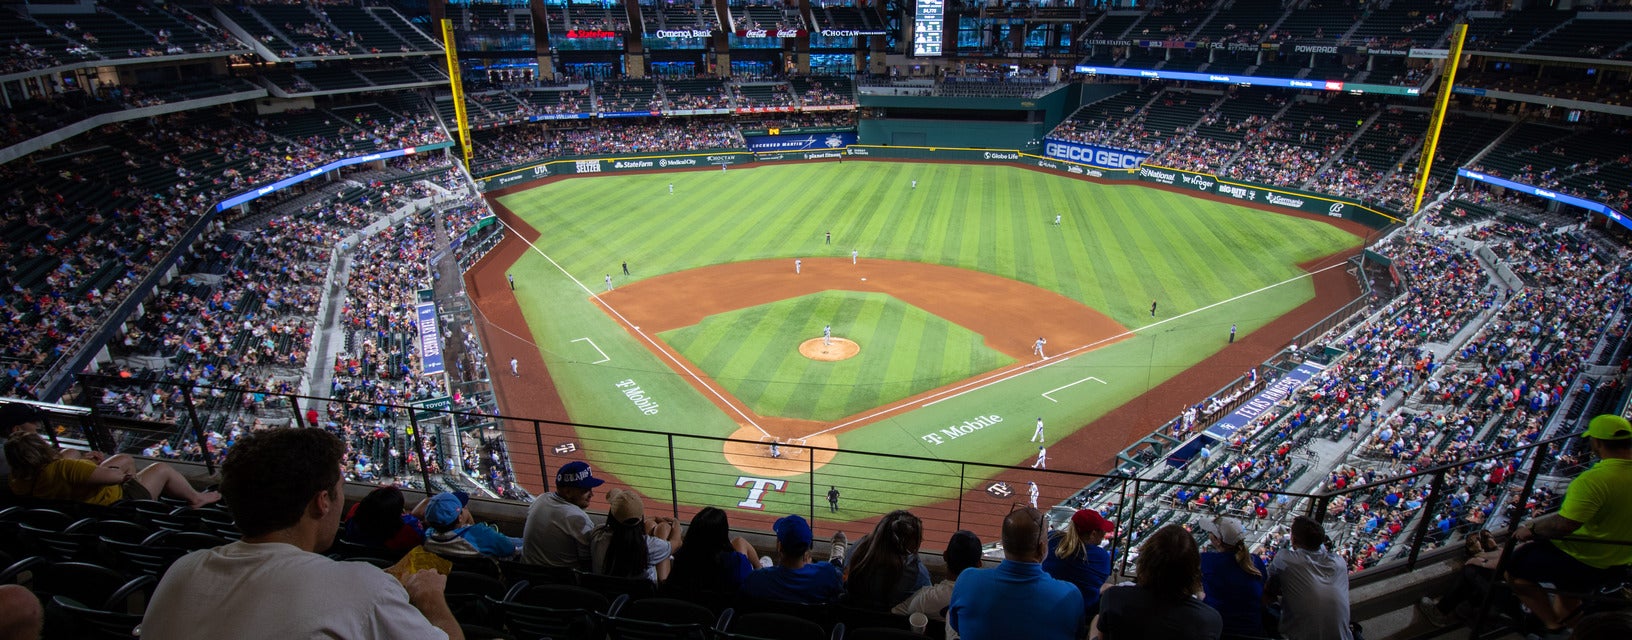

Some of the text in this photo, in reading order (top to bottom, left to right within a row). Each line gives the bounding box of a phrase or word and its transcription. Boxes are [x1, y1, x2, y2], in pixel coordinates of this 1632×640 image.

[692, 29, 712, 38] Bank
[825, 29, 860, 37] CHOCTAW
[1294, 45, 1338, 54] POWERADE
[991, 152, 1007, 160] Globe
[1046, 142, 1094, 163] GEICO
[534, 164, 548, 175] UTA
[576, 163, 601, 174] SELTZER
[1147, 168, 1176, 181] National
[1190, 175, 1214, 191] Kroger
[421, 318, 440, 357] TEXAS RANGERS
[622, 385, 660, 416] Mobile
[1235, 376, 1303, 419] TEXAS RANGERS
[425, 400, 451, 409] TOYOTA
[939, 414, 1004, 440] Mobile
[735, 475, 789, 511] T
